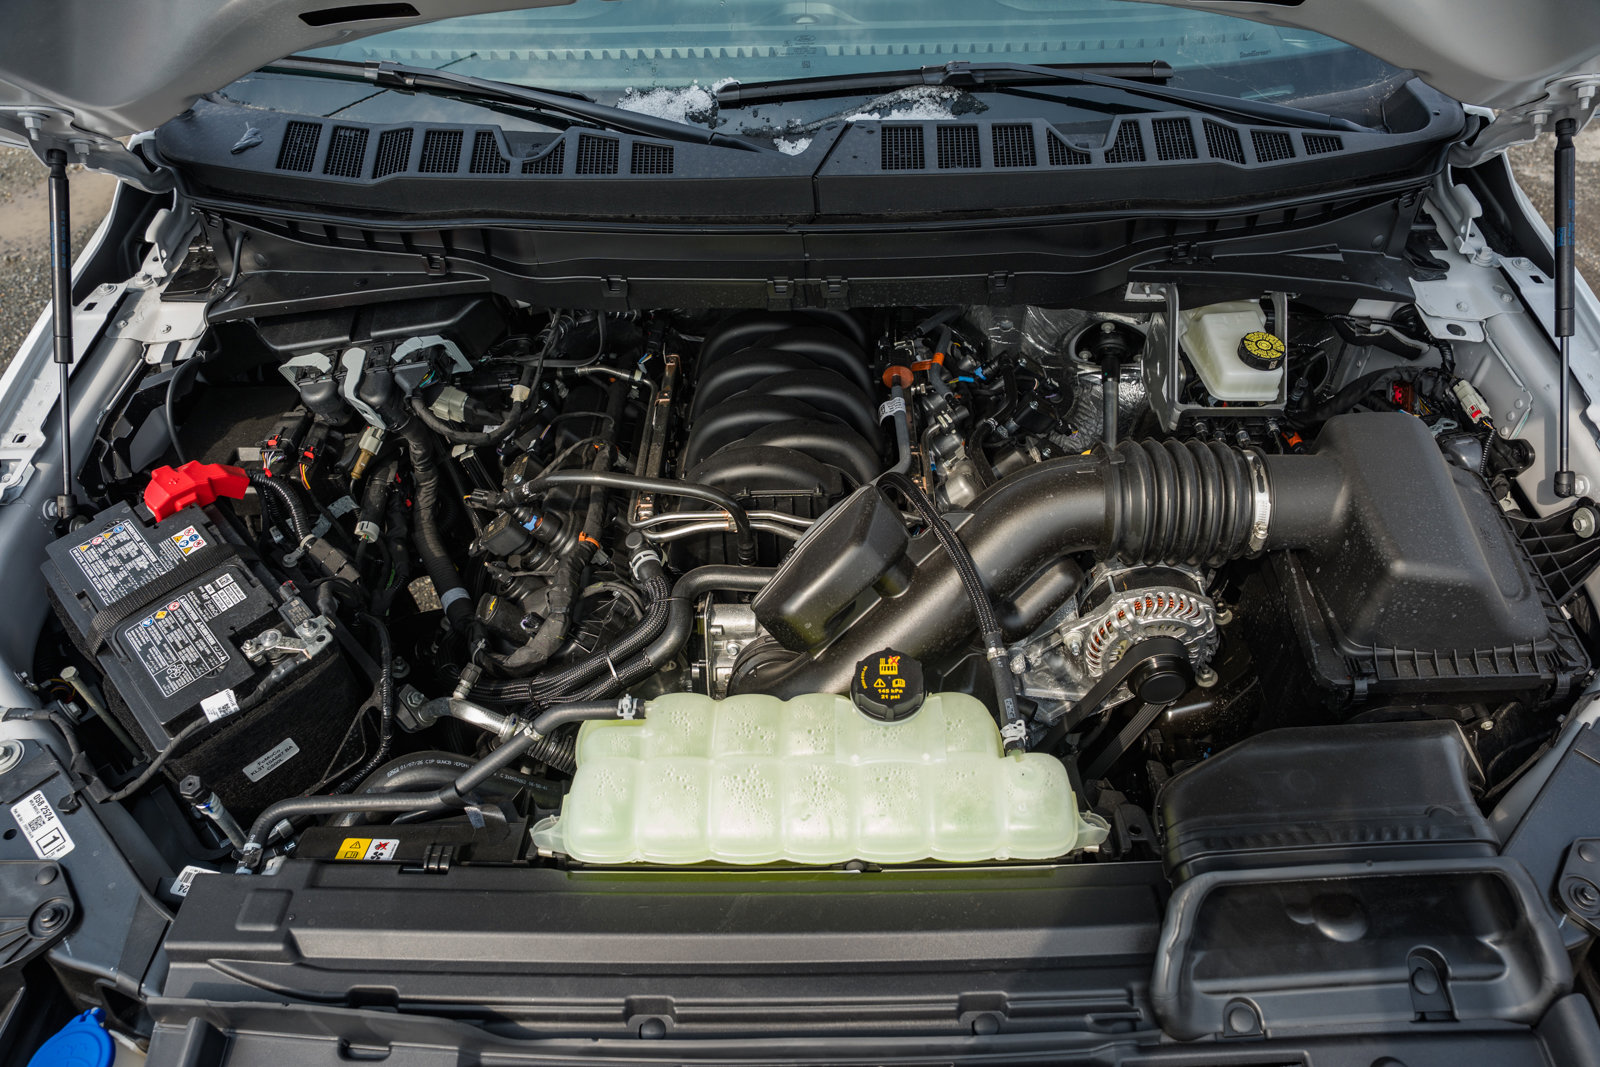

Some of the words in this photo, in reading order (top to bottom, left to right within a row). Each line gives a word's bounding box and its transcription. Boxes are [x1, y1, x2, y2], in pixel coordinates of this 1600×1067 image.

[257, 749, 281, 766] FoMoCo
[33, 793, 46, 807] 058
[40, 805, 55, 822] 2524
[42, 835, 60, 849] 1
